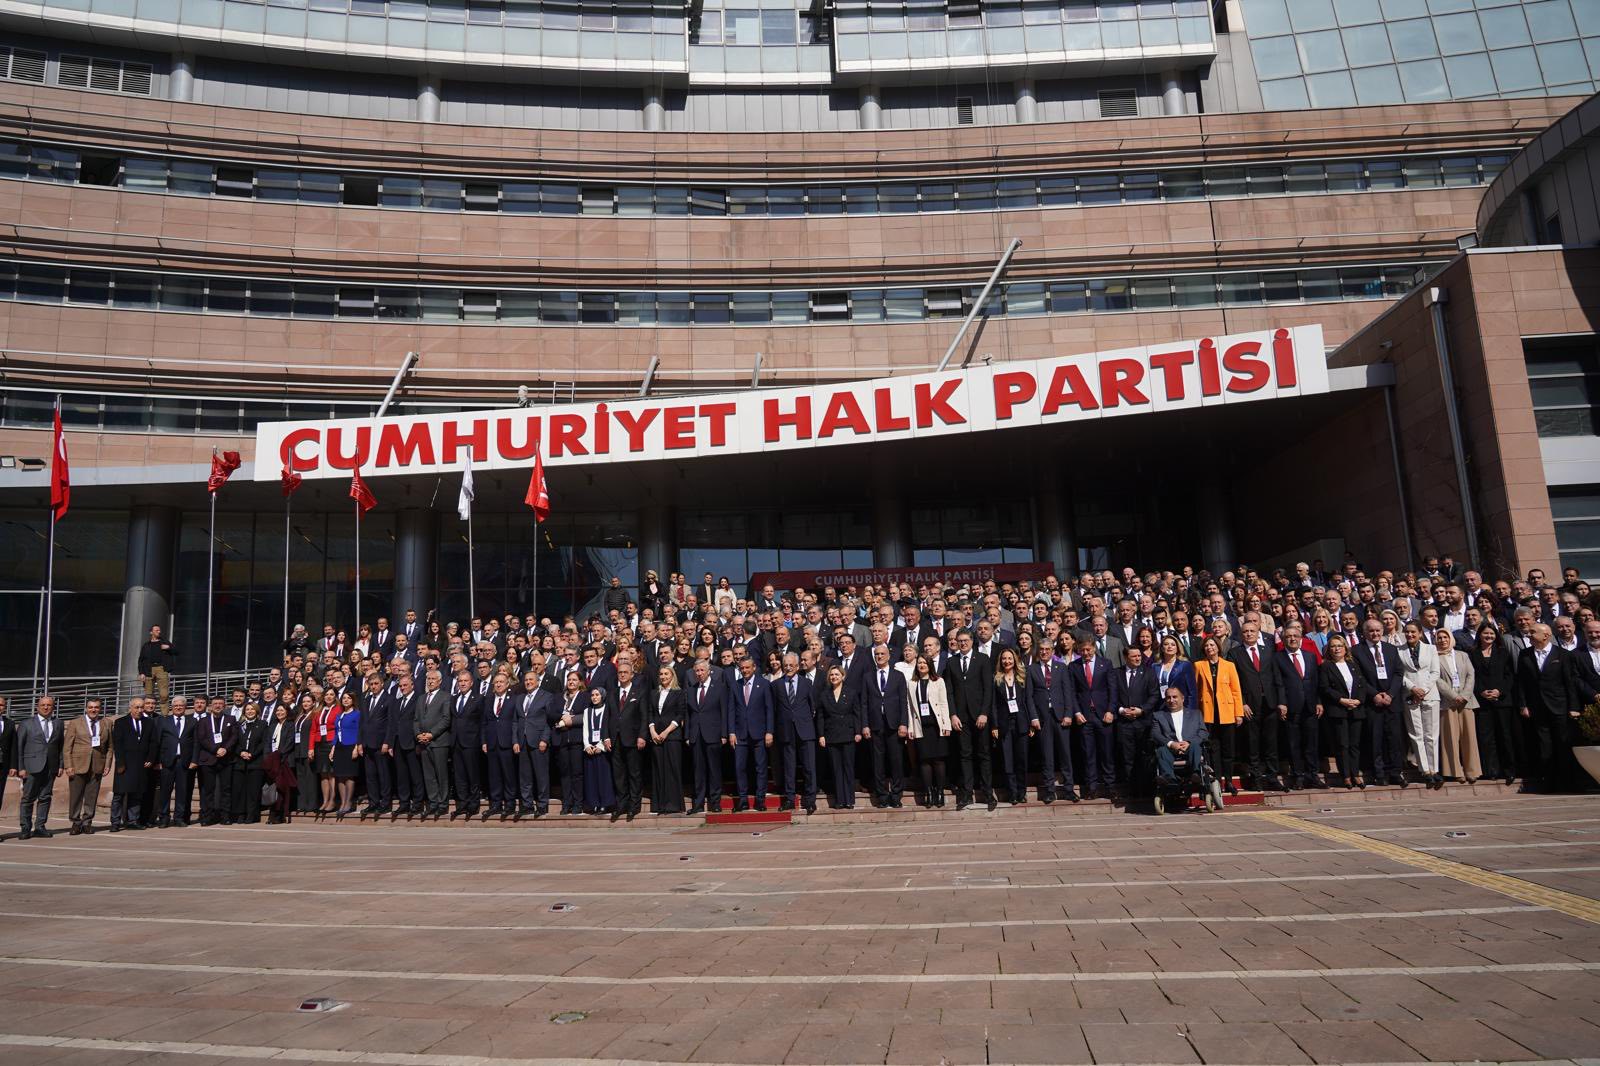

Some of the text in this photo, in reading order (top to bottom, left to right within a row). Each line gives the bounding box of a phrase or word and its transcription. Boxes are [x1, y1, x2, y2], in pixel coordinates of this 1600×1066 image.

[279, 328, 1297, 472] CUMHURİYET HALK PARTİSİ
[815, 568, 995, 585] CUMHURİYET HALK PARTİSİ
